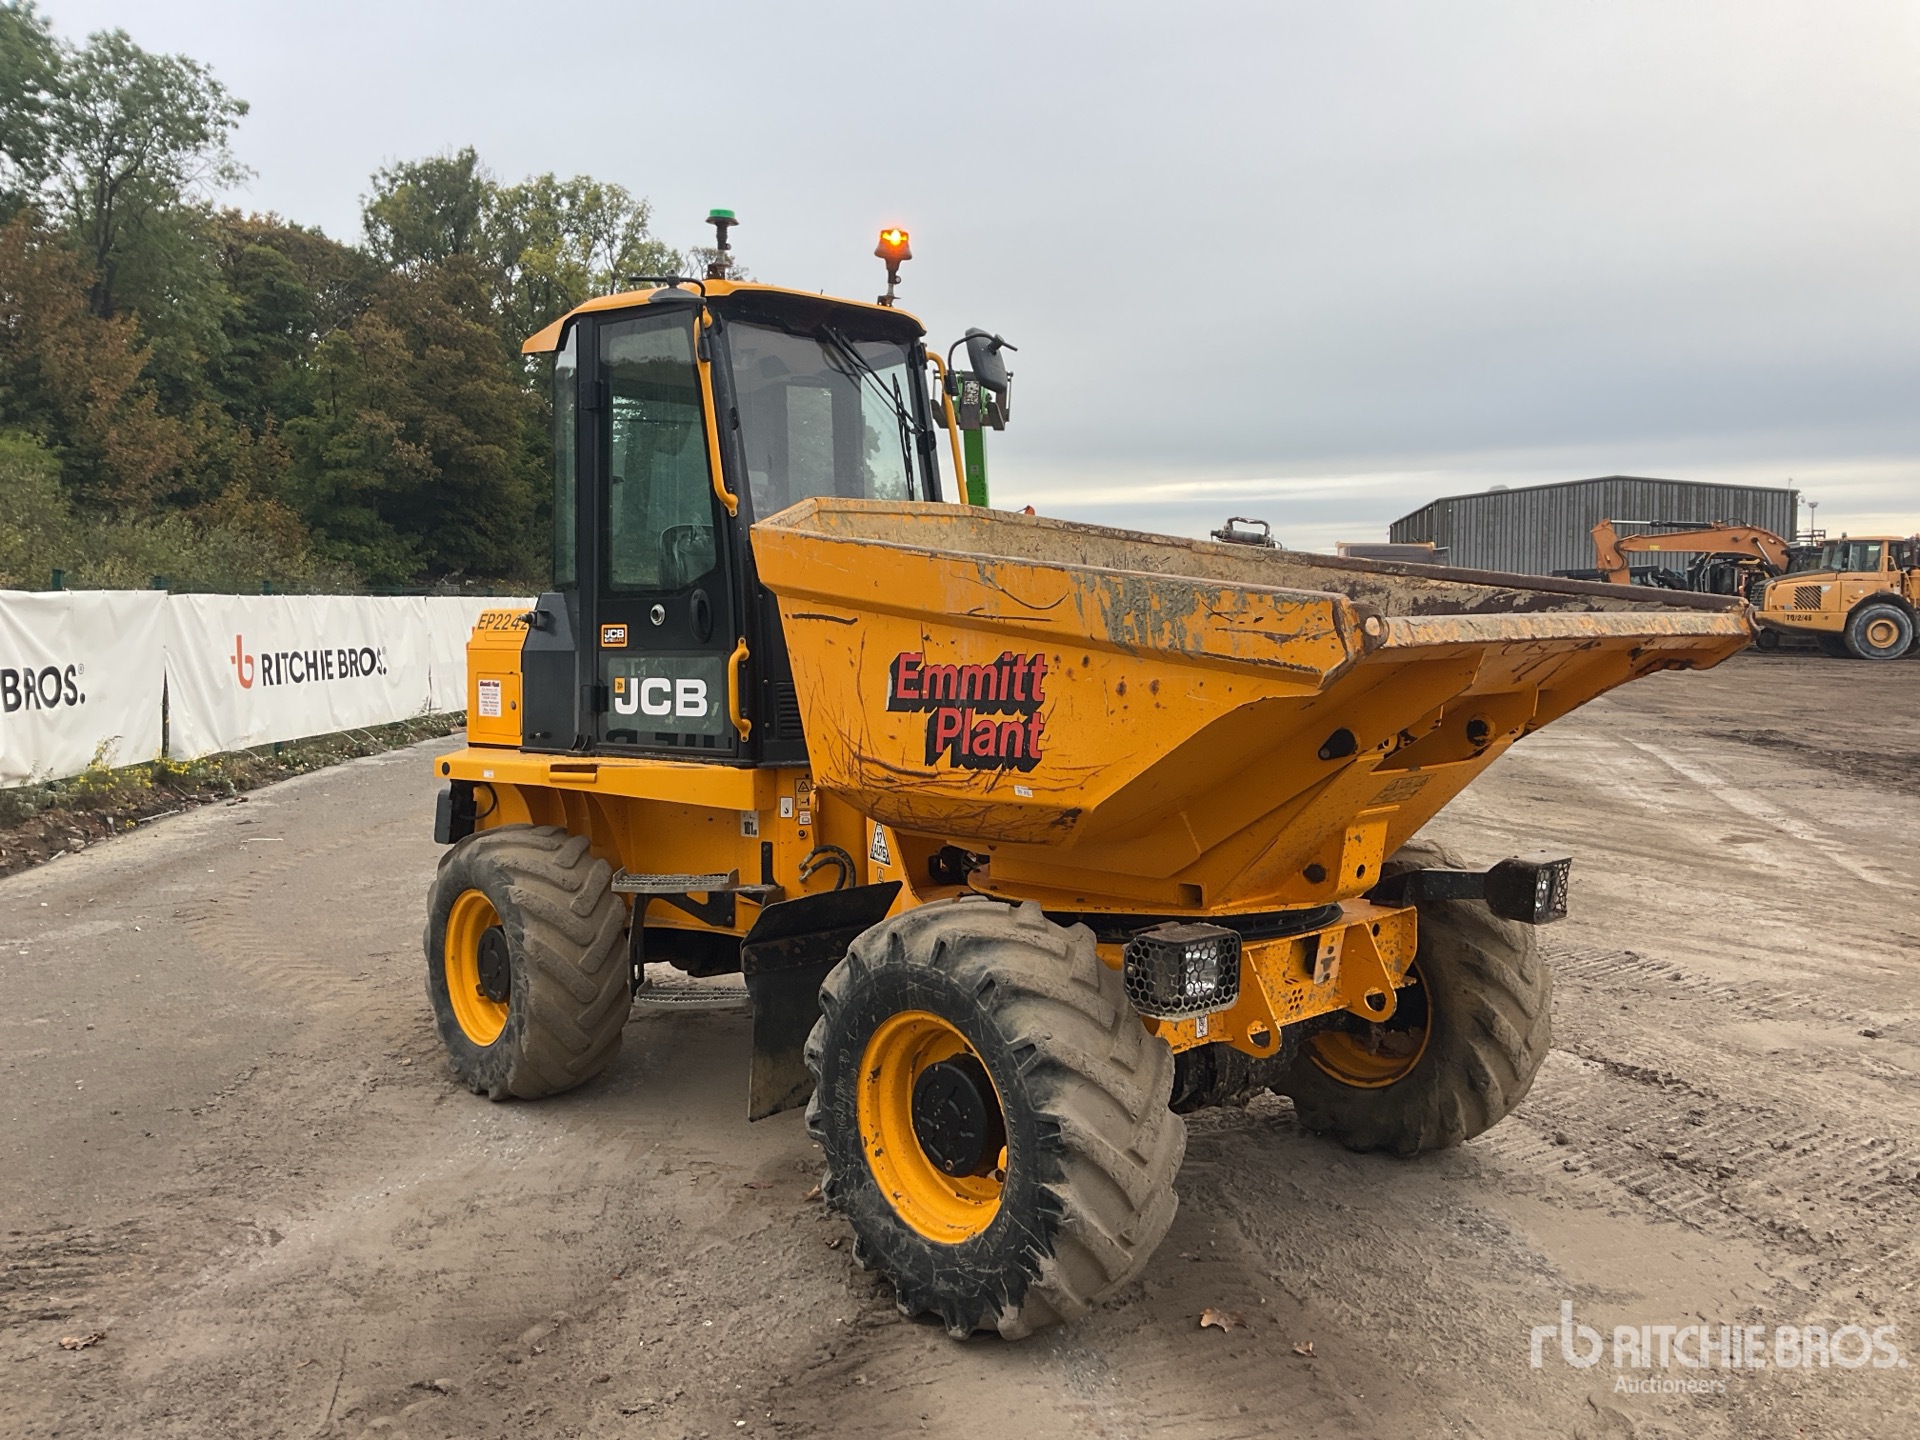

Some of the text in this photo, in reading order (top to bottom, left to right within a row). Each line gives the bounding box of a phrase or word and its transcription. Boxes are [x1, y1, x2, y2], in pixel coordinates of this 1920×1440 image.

[605, 629, 625, 638] JCB
[261, 650, 334, 686] RITCHIE
[889, 651, 1048, 707] Emmitt
[614, 677, 708, 717] JCB
[929, 706, 1045, 764] Plant
